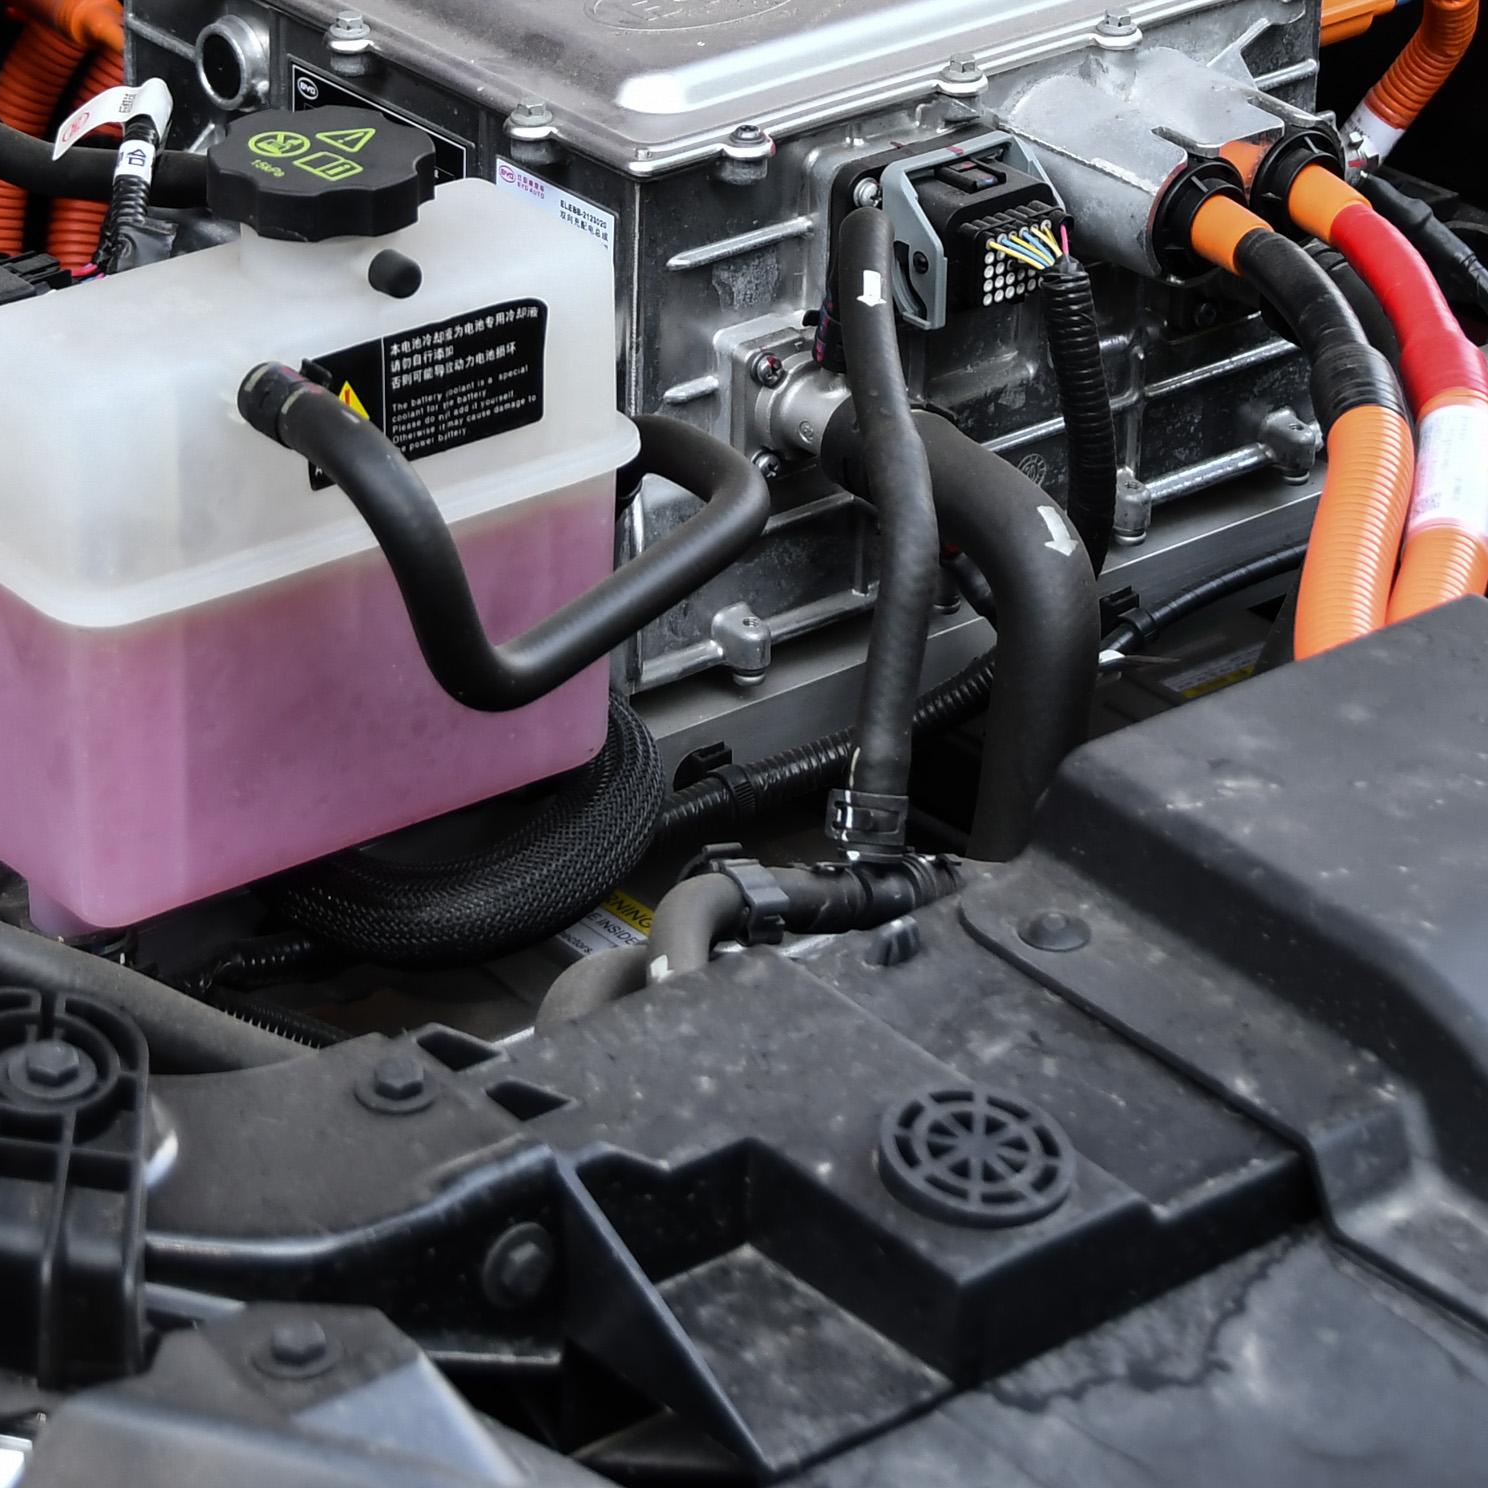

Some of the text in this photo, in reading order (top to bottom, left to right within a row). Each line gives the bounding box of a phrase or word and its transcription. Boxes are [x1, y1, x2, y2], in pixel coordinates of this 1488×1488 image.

[389, 306, 539, 357] 本电池冷却液为电池专用冷却液
[390, 344, 455, 373] 请勿自行添加
[391, 341, 517, 390] 否则可能导致动力电池损坏
[392, 402, 408, 412] The
[411, 392, 443, 406] battery
[477, 378, 485, 387] is
[498, 364, 529, 382] special
[392, 408, 424, 423] coolant
[426, 403, 439, 412] for
[457, 389, 487, 405] battery
[392, 419, 422, 434] Please
[424, 415, 436, 424] do
[453, 406, 469, 416] add
[471, 402, 478, 410] it
[480, 390, 514, 408] yourself
[392, 394, 537, 444] Otherwise it may cause damage to
[409, 437, 435, 451] power
[437, 427, 468, 442] battery
[598, 918, 641, 946] INSIDE
